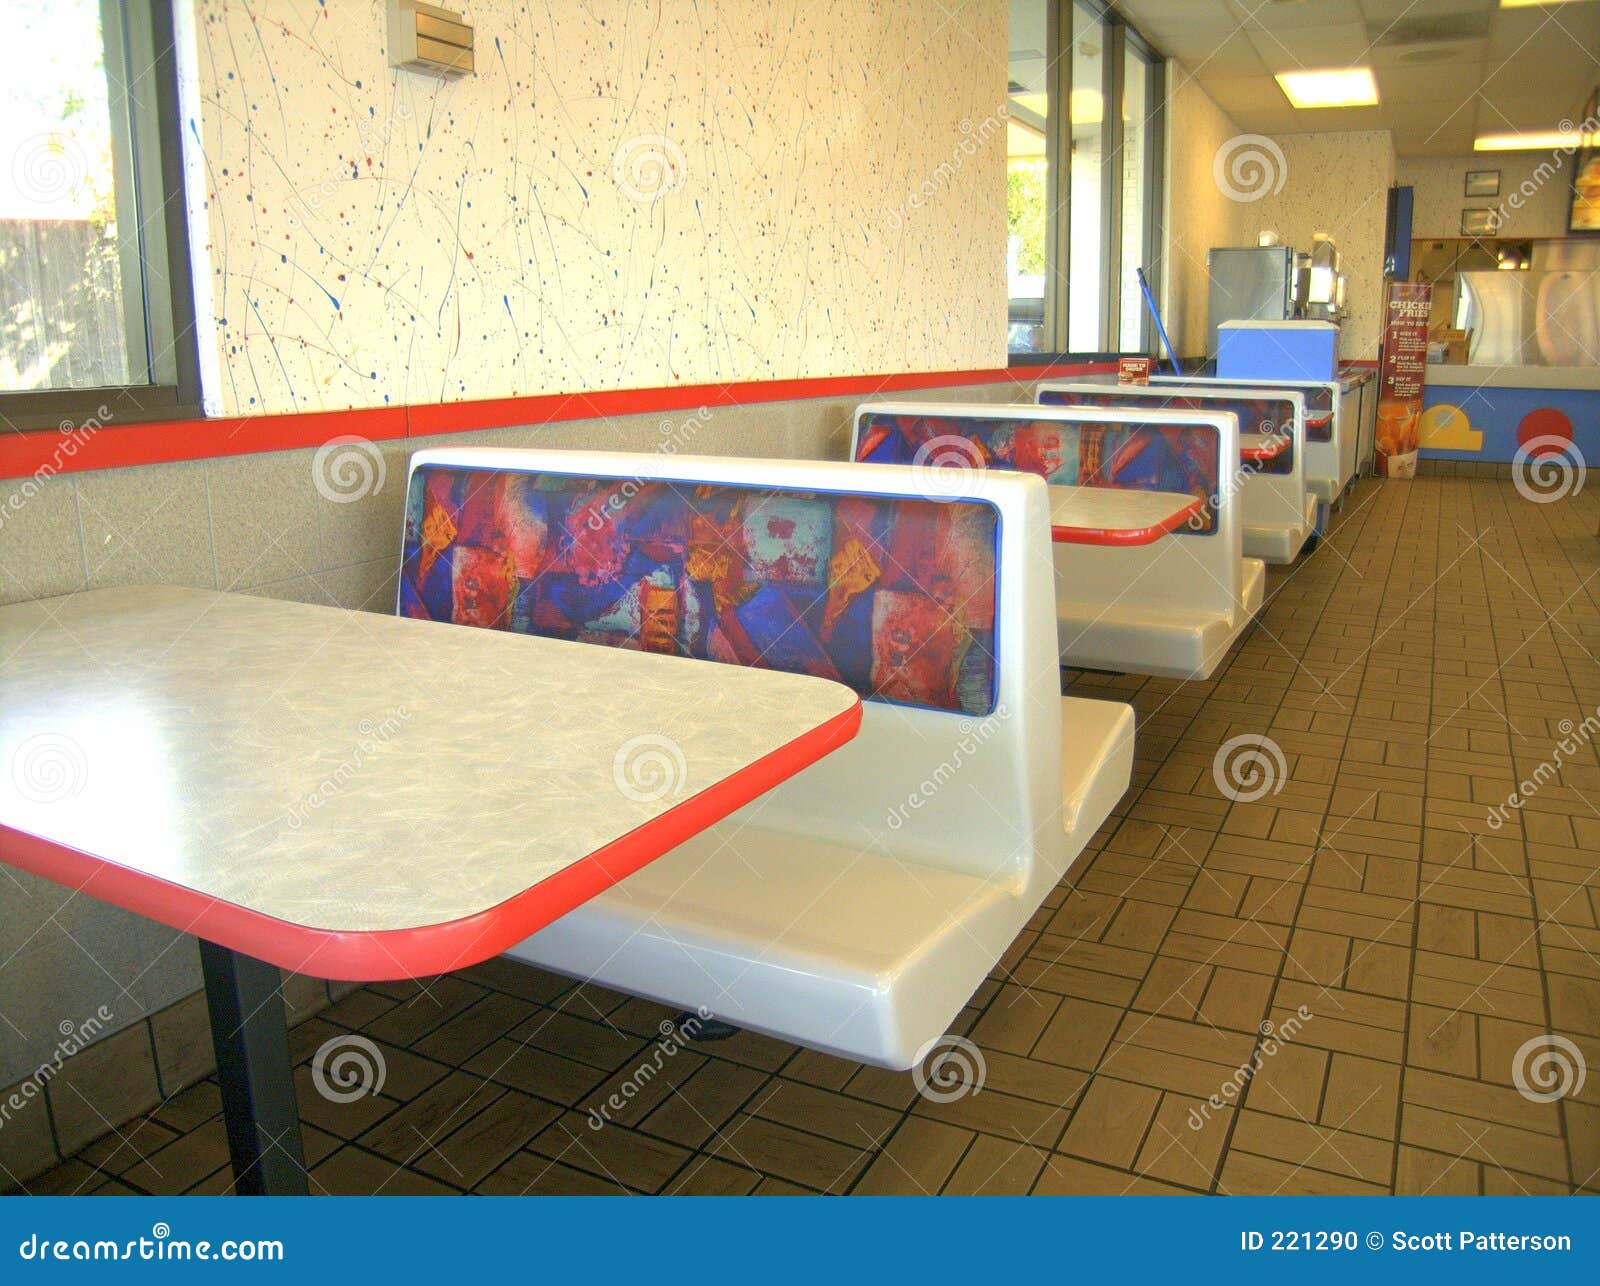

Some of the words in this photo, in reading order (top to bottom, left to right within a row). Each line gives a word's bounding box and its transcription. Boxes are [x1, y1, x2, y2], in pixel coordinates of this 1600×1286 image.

[1392, 331, 1398, 340] 1
[1389, 355, 1397, 363] 2
[1387, 376, 1395, 385] 3
